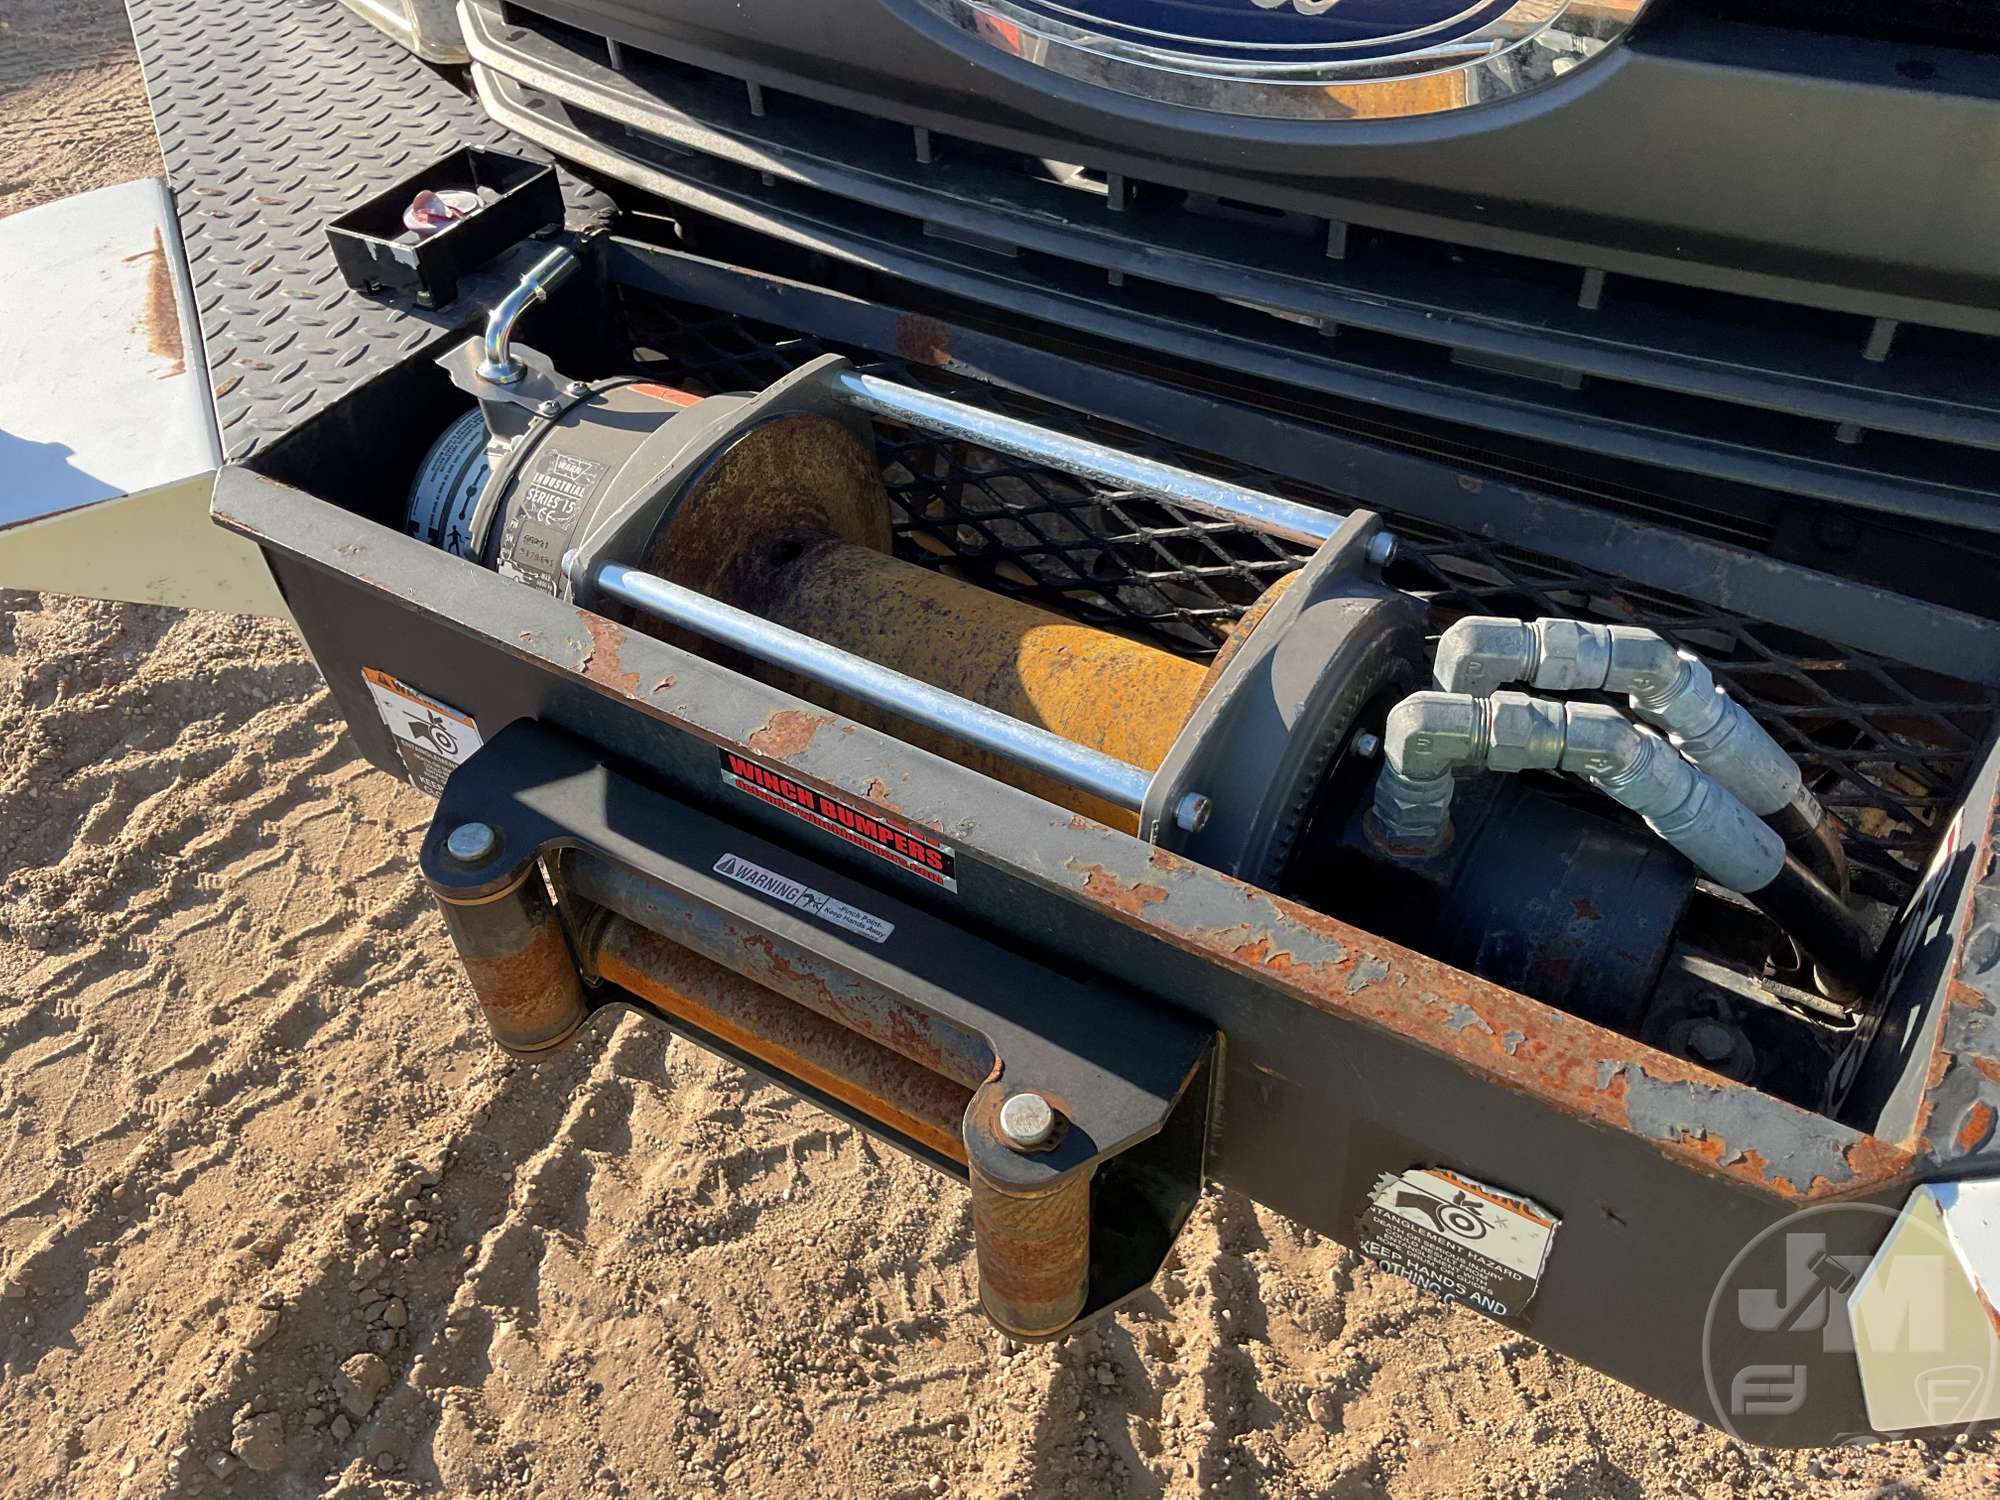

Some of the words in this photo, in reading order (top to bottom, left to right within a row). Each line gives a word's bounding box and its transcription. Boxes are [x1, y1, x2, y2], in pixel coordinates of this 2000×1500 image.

[533, 472, 586, 498] INDUSTRIAL
[557, 461, 584, 475] WARN
[526, 487, 561, 510] SERIES
[562, 499, 576, 514] 15
[728, 754, 815, 810] WINCH
[819, 797, 943, 870] BUMPERS
[735, 864, 801, 902] WARNING
[823, 906, 843, 921] Keep
[843, 914, 867, 930] Hands
[866, 924, 886, 938] Away
[1369, 1206, 1465, 1254] NTANGLEMENT
[1467, 1251, 1524, 1282] HAZARD
[1373, 1215, 1406, 1236] DEATH
[1406, 1231, 1423, 1244] OR
[1422, 1238, 1467, 1264] SERIOUS
[1468, 1259, 1504, 1282] INJURY
[1383, 1232, 1461, 1276] ENTANGLEMENT
[1462, 1270, 1489, 1287] WITH
[1384, 1227, 1419, 1248] COULD
[1419, 1243, 1458, 1267] RESULT
[1459, 1261, 1490, 1281] FROM
[1359, 1239, 1403, 1262] KEEP
[1406, 1259, 1467, 1297] HANDS
[1469, 1292, 1508, 1317] AND
[1378, 1259, 1442, 1294] OTHING
[1439, 1265, 1455, 1278] OR
[1456, 1273, 1494, 1296] GUIDES
